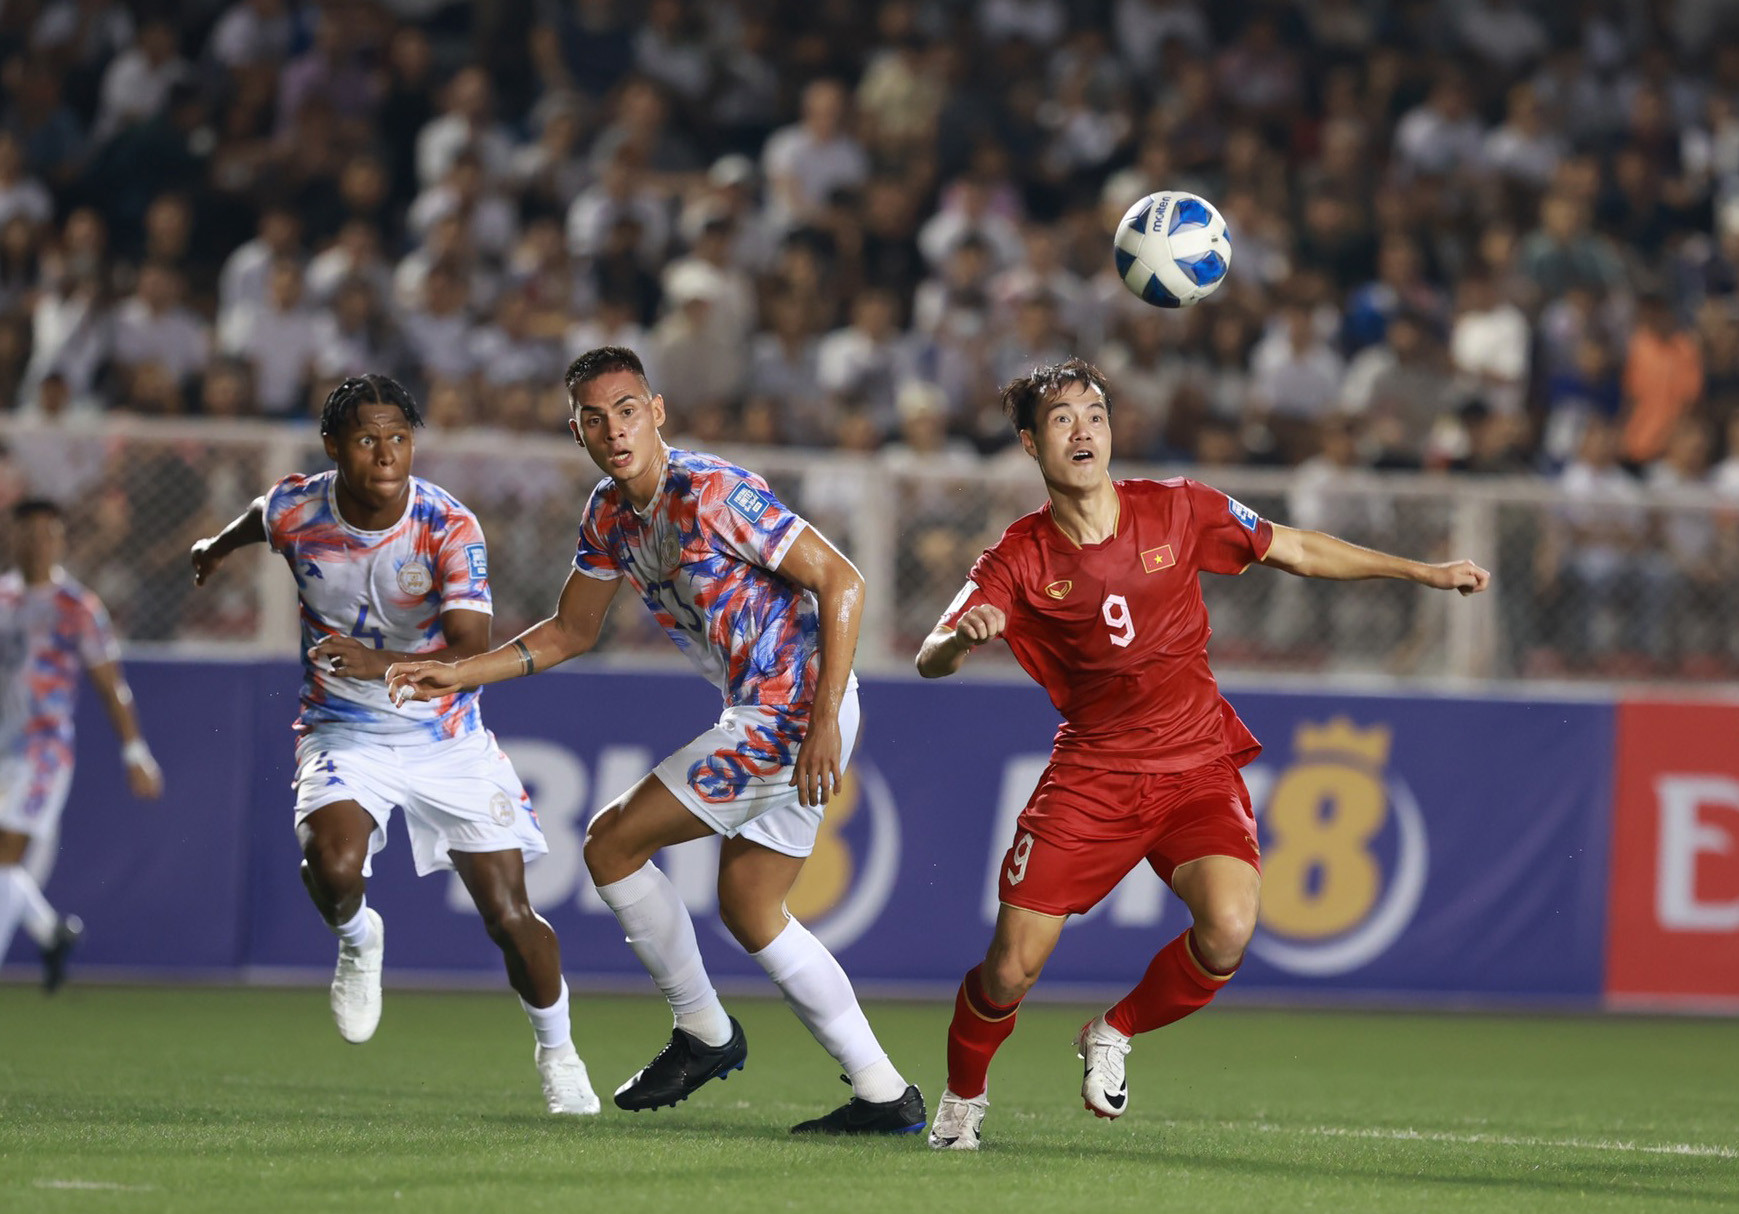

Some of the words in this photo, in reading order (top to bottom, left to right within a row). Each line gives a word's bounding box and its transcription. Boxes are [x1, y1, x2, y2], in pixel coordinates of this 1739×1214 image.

[1152, 196, 1171, 232] molten
[351, 604, 387, 649] 4
[1102, 593, 1136, 648] 9
[315, 750, 337, 772] 4
[1007, 832, 1034, 886] 9
